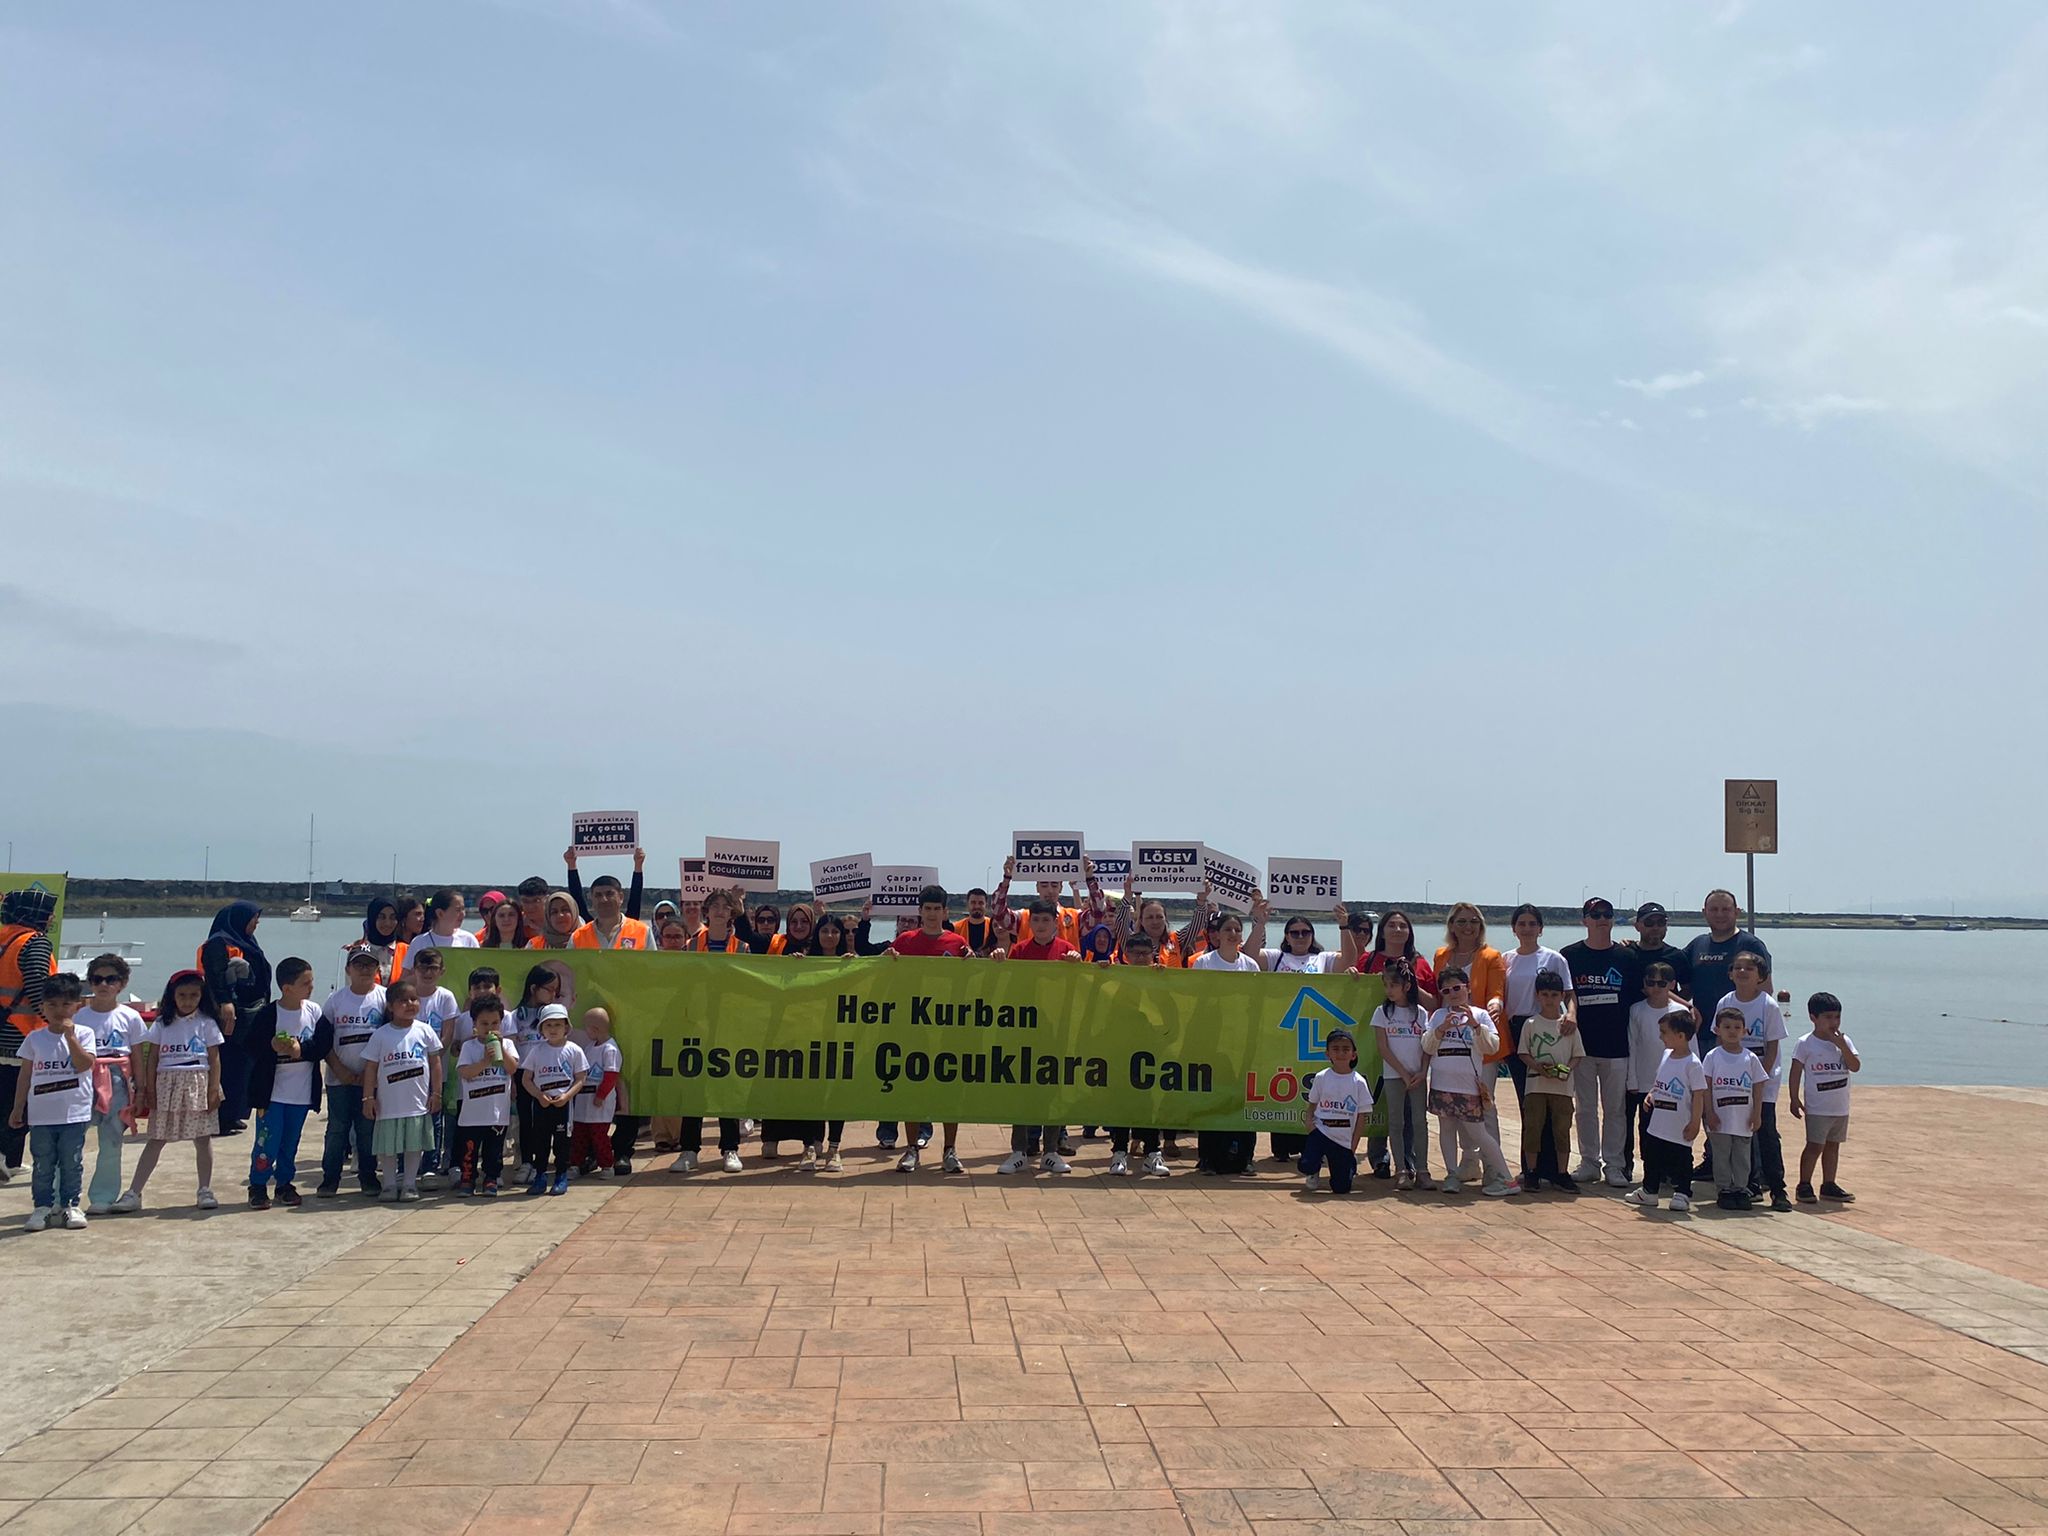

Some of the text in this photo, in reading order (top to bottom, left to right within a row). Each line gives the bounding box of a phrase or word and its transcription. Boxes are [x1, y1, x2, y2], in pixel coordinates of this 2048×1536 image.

[578, 823, 631, 834] bir çocuk
[583, 833, 626, 843] KANSER
[1021, 843, 1074, 857] LÖSEV
[714, 852, 768, 863] HAYATIMIZ
[1143, 850, 1192, 863] LÖSEV
[710, 865, 771, 876] çocuklarımız
[823, 862, 858, 874] Kanser
[1016, 862, 1079, 873] farkında
[1092, 860, 1126, 872] ÖSEV
[1203, 857, 1256, 884] KANSERLE
[684, 874, 704, 882] BİR
[820, 872, 863, 884] önlenebilir
[886, 874, 923, 884] Çarpar
[1134, 874, 1202, 884] önemsiyoruz
[1270, 873, 1337, 886] KANSERE
[816, 880, 870, 894] bir hastalıktır
[881, 884, 922, 892] Kalbimi
[1270, 884, 1337, 897] DUR DE
[837, 995, 1038, 1029] Her Kurban
[650, 1038, 1213, 1094] Lösemili Çocuklara Can
[1244, 1108, 1297, 1122] Lösemili
